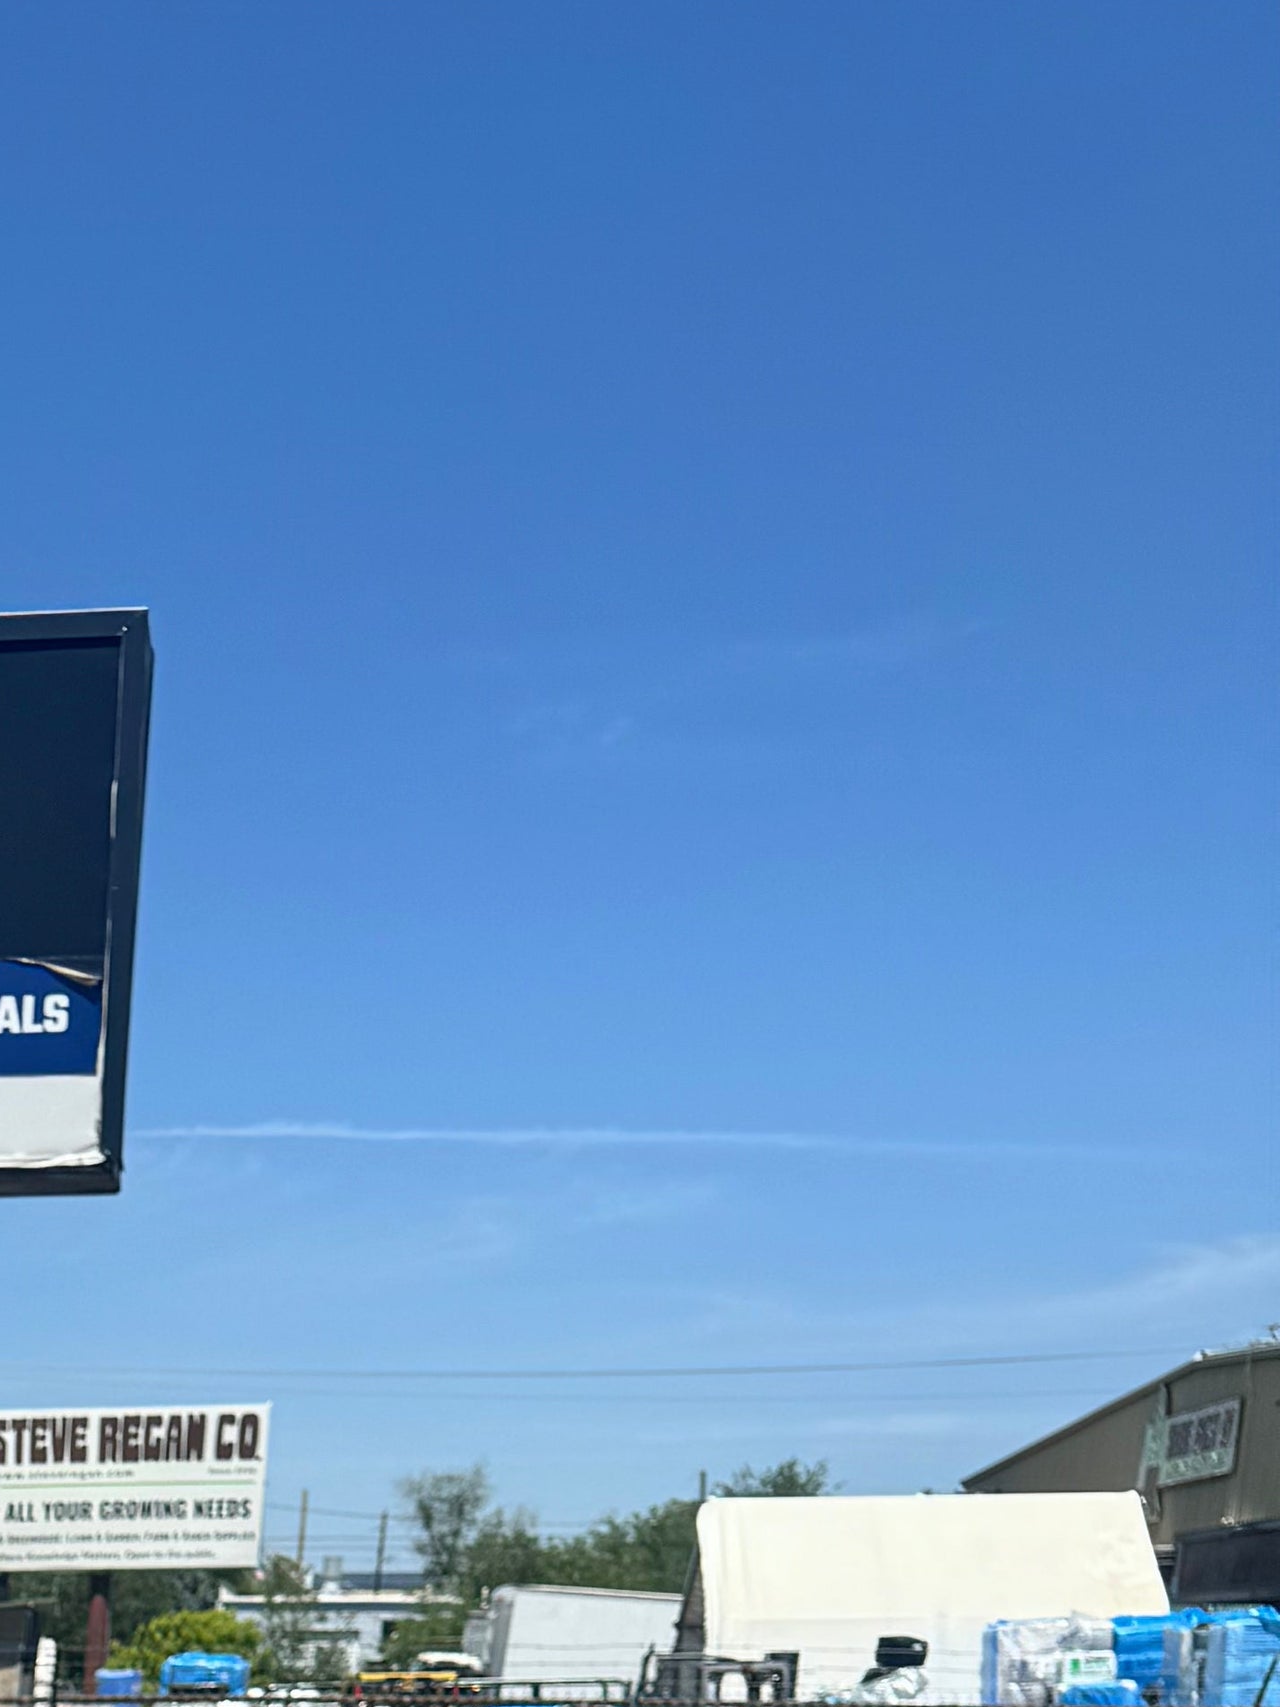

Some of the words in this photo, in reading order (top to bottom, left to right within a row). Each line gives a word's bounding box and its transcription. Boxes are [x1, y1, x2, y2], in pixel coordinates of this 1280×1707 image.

[99, 1413, 206, 1463] REGAN
[5, 1502, 37, 1523] ALL
[43, 1501, 93, 1522] YOUR
[99, 1500, 188, 1521] GROWING
[192, 1498, 252, 1520] NEEDS
